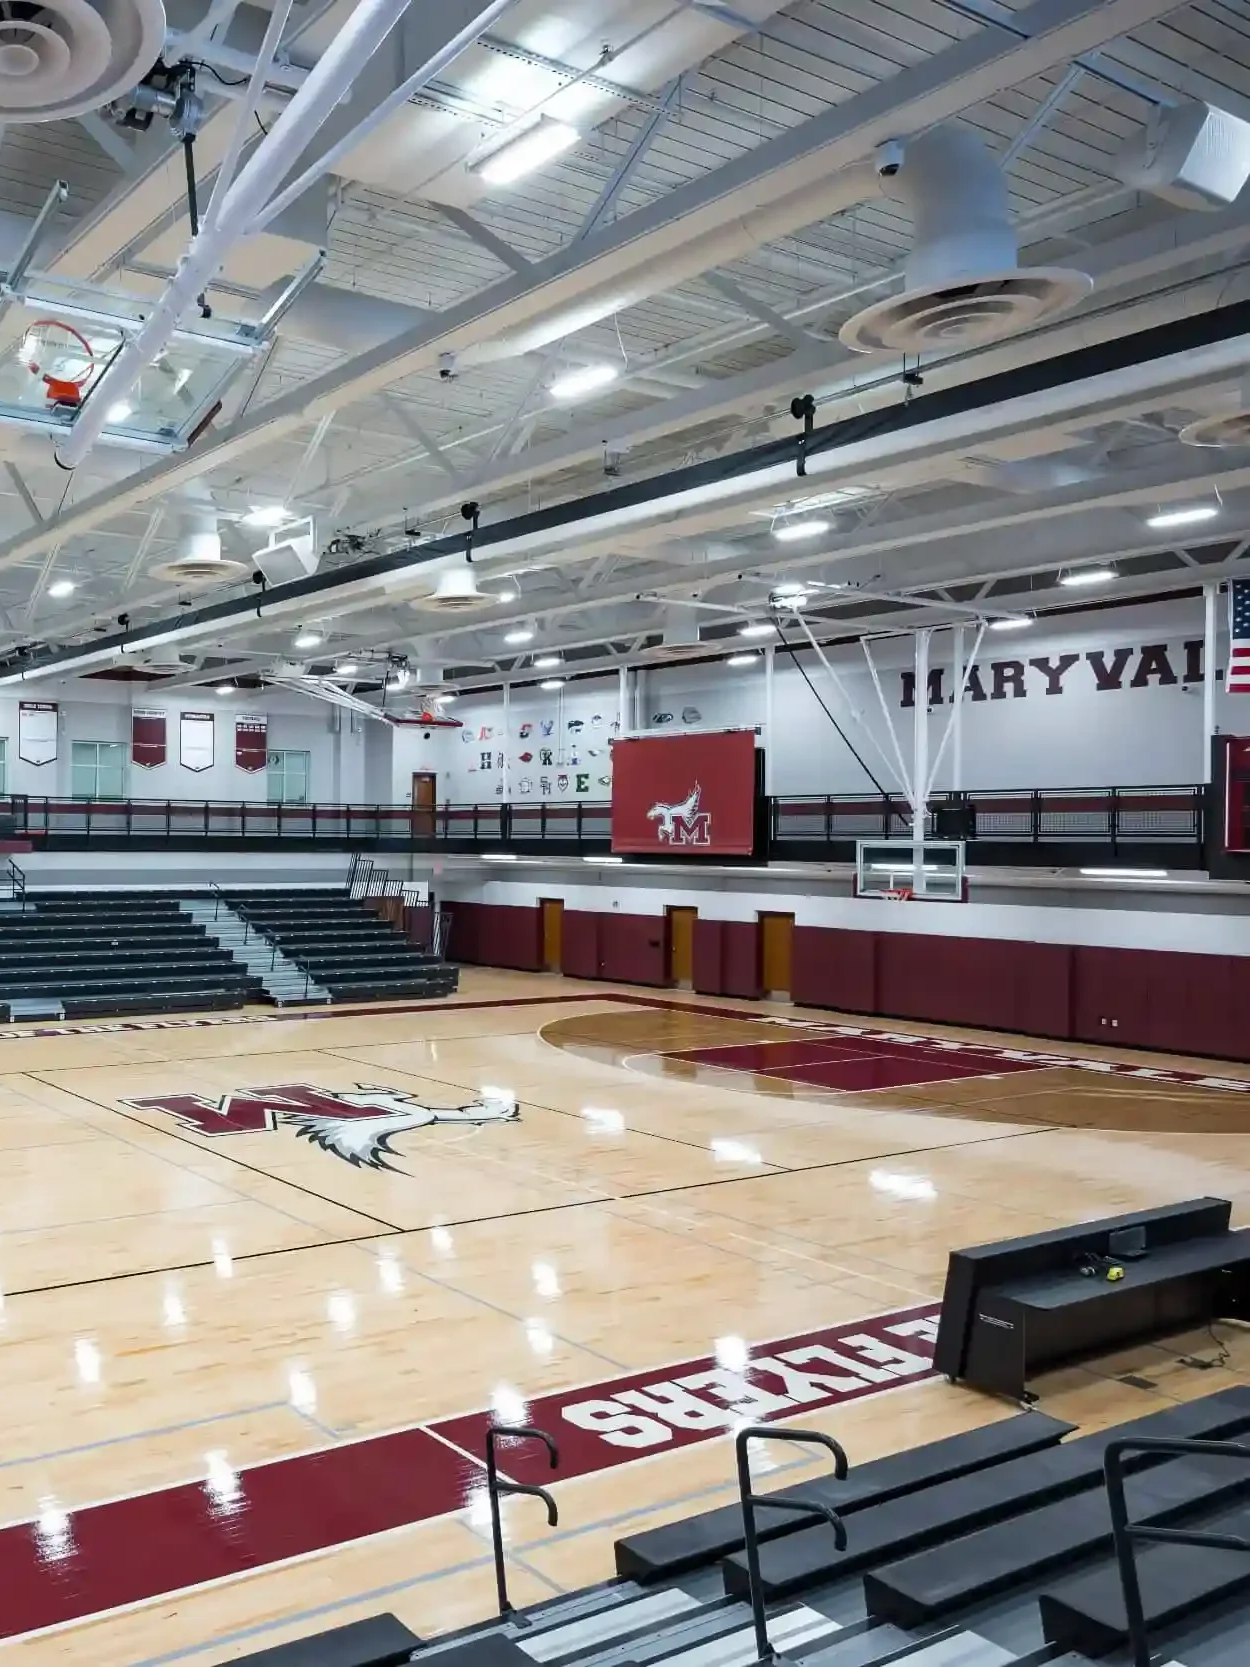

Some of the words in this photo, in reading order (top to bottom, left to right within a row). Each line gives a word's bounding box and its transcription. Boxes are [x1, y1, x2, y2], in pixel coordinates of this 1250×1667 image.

[575, 773, 590, 793] E
[669, 813, 711, 847] M
[45, 1022, 131, 1035] THE
[561, 1332, 934, 1449] FLYERS
